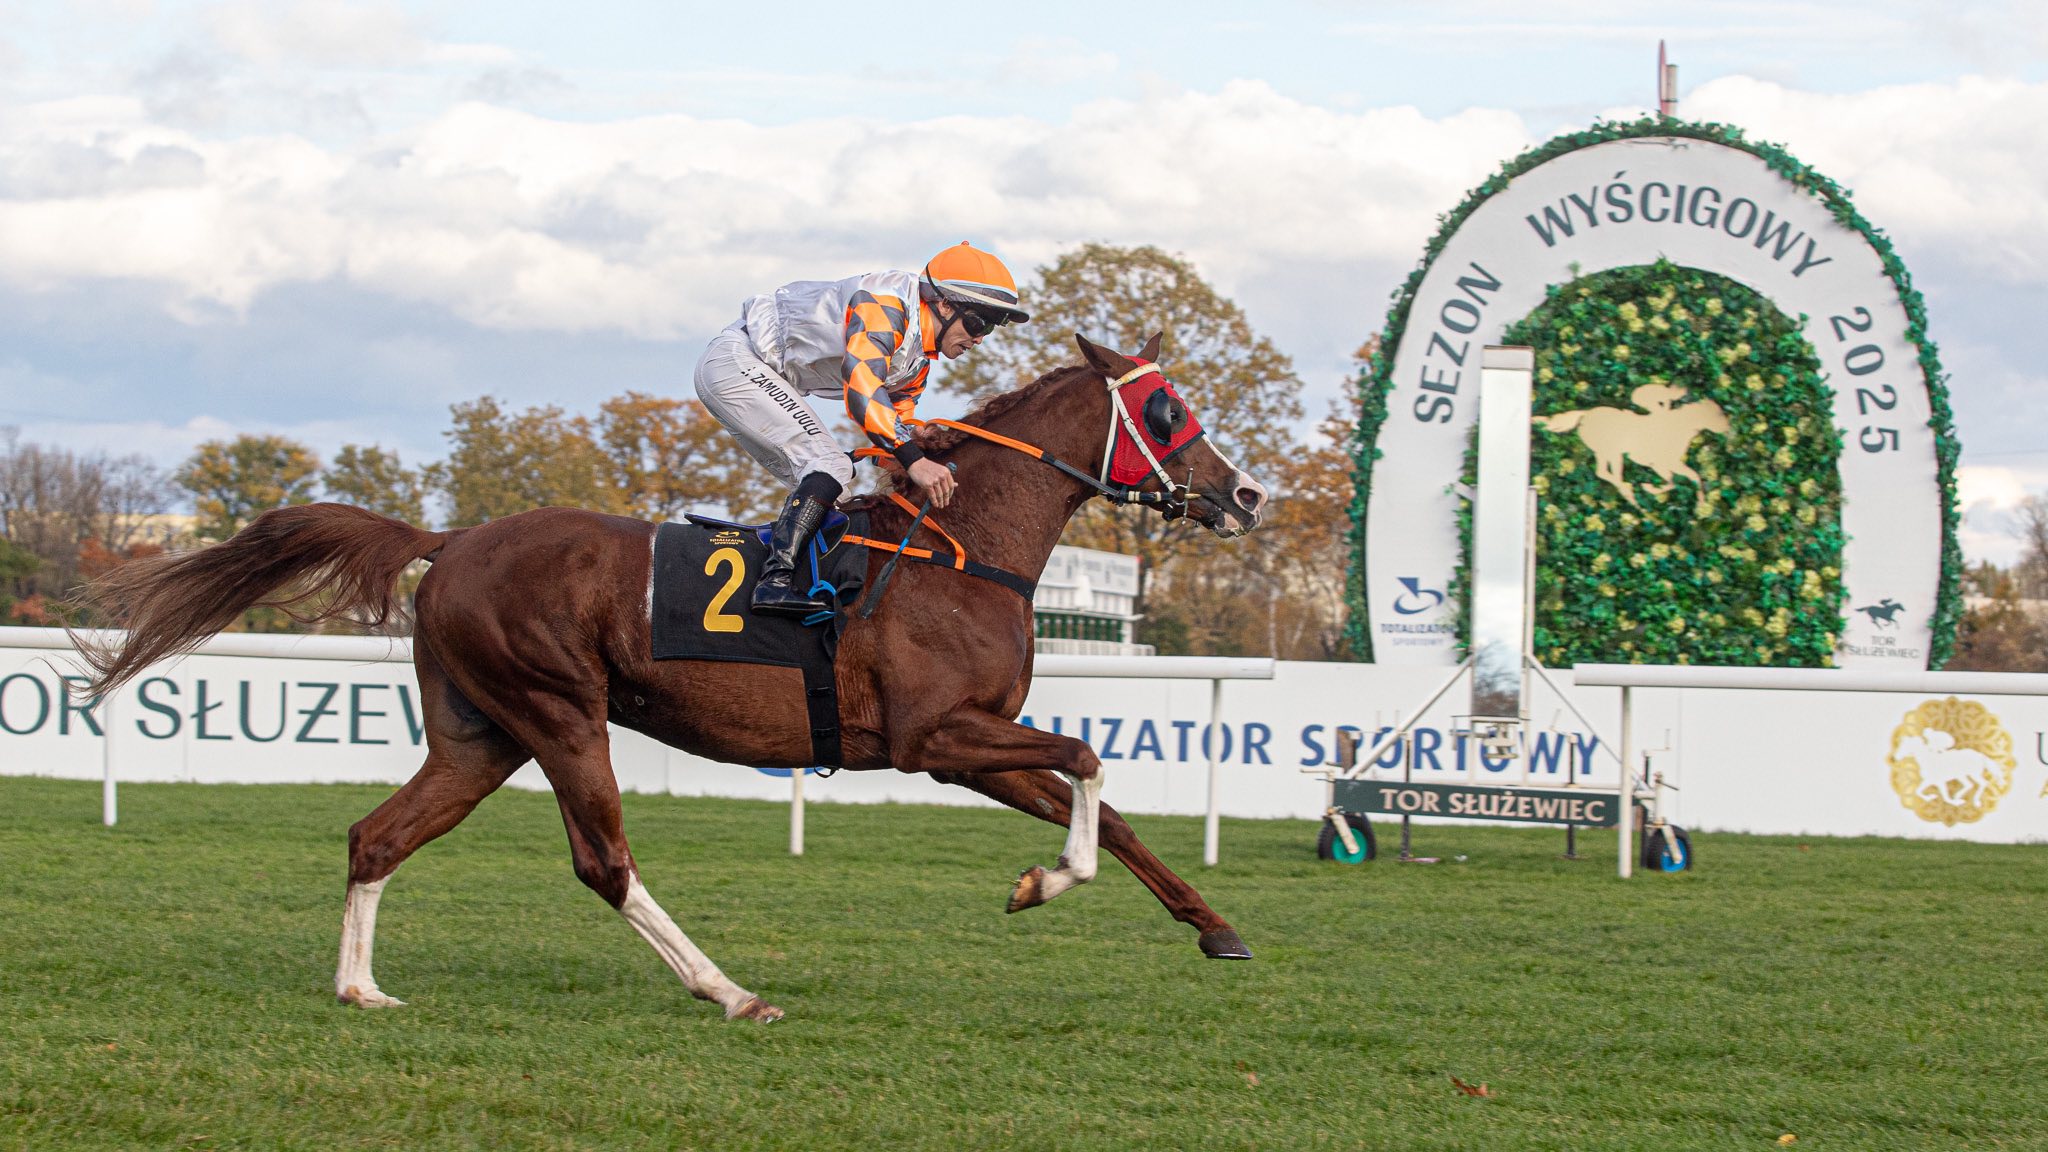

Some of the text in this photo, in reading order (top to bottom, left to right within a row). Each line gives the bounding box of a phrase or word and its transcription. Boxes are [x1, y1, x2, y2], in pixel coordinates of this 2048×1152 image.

[1413, 170, 1900, 454] SEZON WYŚCIGOWY 2025
[750, 373, 822, 436] ZAMUDIN UULU
[703, 547, 746, 632] 2
[1379, 788, 1606, 822] TOR SŁUŻEWIEC
